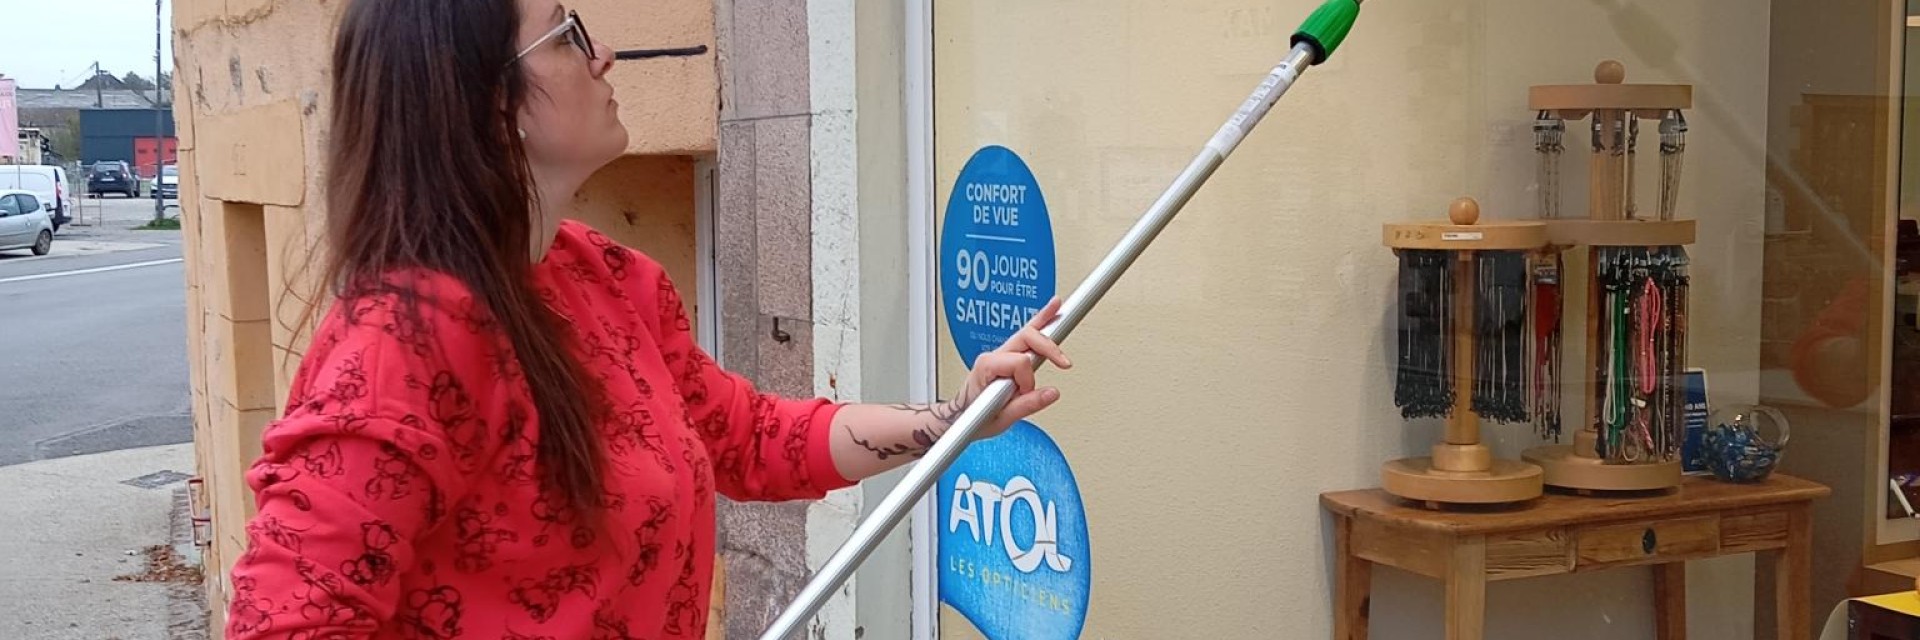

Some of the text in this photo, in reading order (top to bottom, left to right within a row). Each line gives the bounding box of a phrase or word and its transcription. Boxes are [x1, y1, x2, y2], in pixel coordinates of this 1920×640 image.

[966, 183, 1026, 205] CONFORT
[973, 205, 1019, 226] DE VUE
[956, 249, 1038, 291] 90 JOURS
[990, 281, 1037, 299] POUR ÊTRE
[950, 473, 1072, 572] ATOL
[950, 555, 1070, 614] LES OPTICENS
